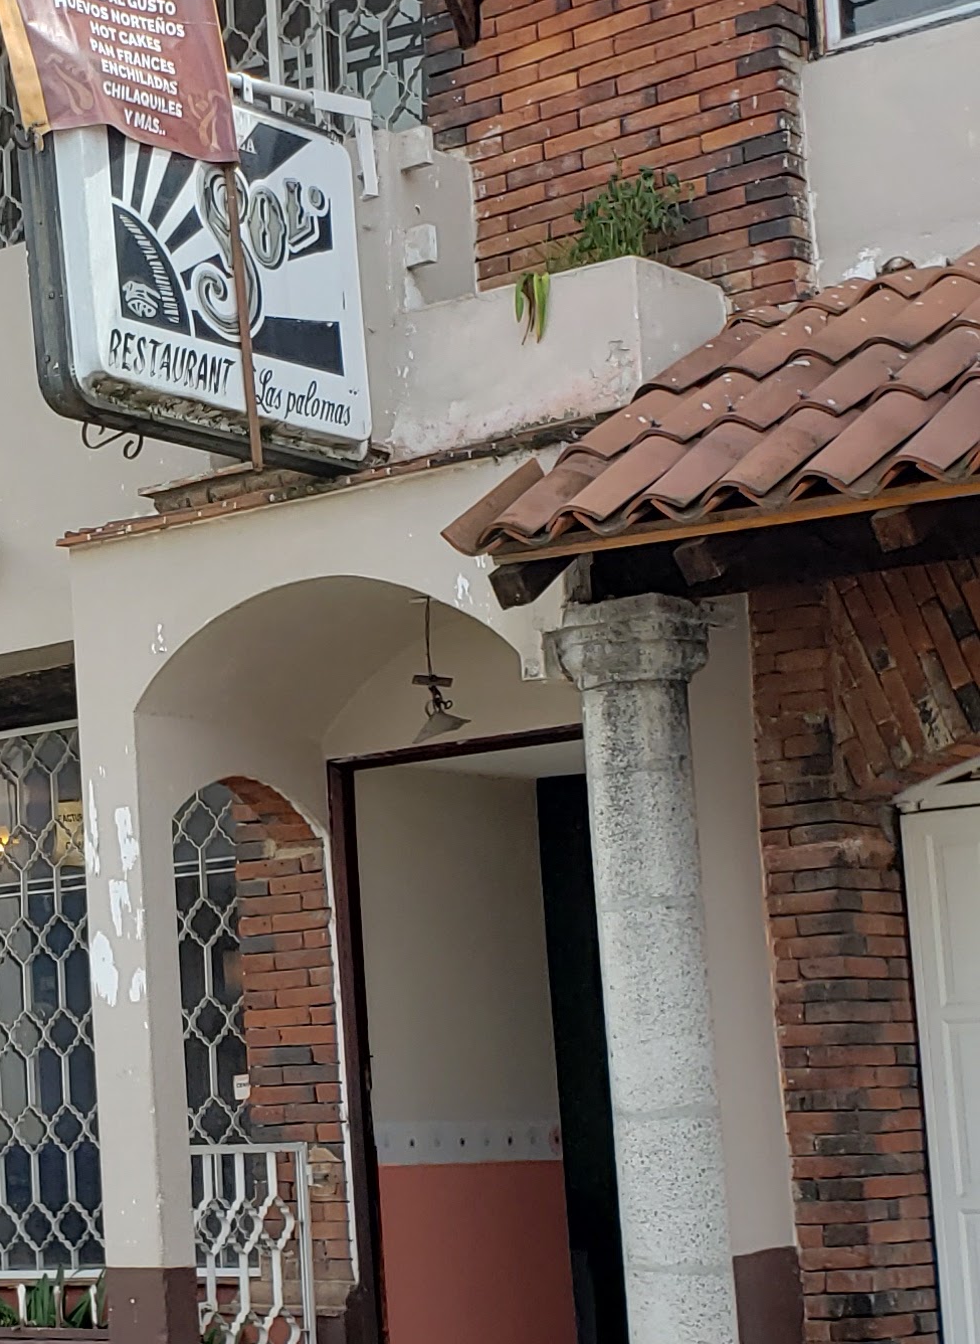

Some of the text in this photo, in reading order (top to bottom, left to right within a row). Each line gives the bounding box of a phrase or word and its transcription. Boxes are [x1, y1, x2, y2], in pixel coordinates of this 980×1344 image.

[89, 20, 162, 53] HOT CAKES
[111, 8, 186, 38] NORTEÑOS
[89, 38, 176, 75] PAN FRANCES
[101, 58, 178, 96] ENCHILADAS
[103, 80, 183, 119] CHILAQUILES
[124, 108, 134, 126] Y
[108, 328, 236, 396] RESTAURANT
